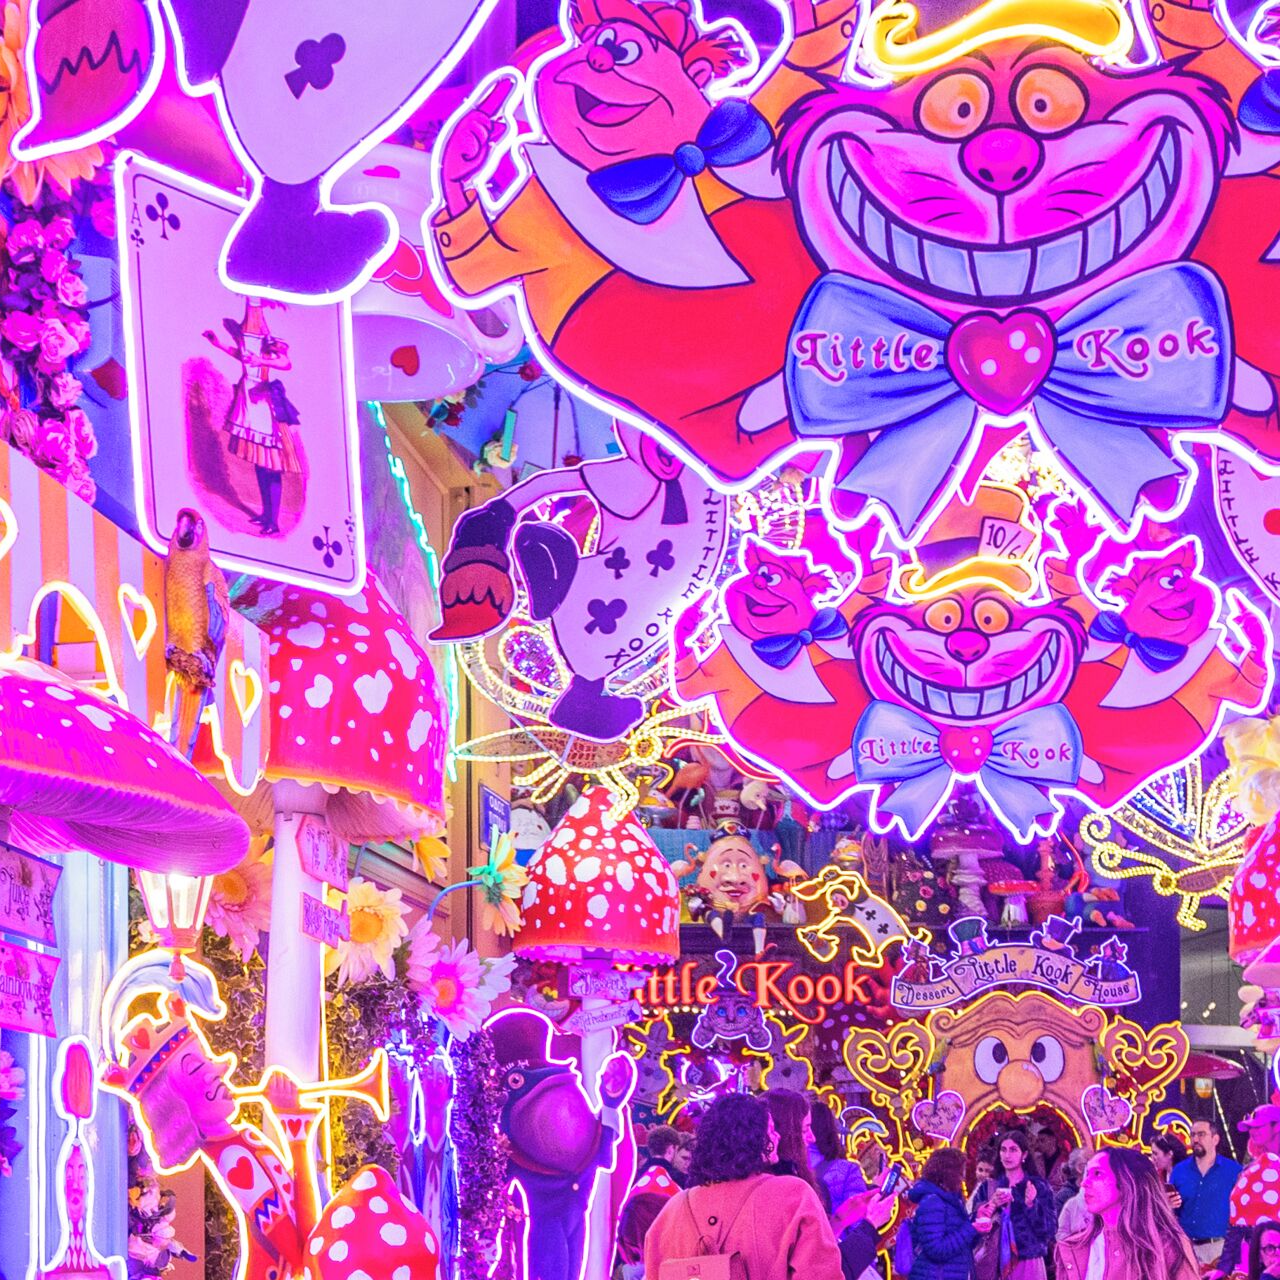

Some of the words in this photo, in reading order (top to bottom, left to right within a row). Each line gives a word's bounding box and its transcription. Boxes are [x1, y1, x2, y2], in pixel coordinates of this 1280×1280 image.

[794, 332, 937, 383] Little
[1076, 320, 1219, 379] Kook
[680, 488, 721, 599] LITTLE
[985, 523, 1022, 561] 10/6
[605, 607, 673, 667] KOOK
[860, 737, 934, 765] Little
[1003, 739, 1072, 769] Kook
[954, 952, 1018, 985] Little
[1032, 954, 1074, 986] Kook
[734, 960, 872, 1025] Kook
[896, 983, 956, 1006] Dessert
[1084, 978, 1131, 1003] House
